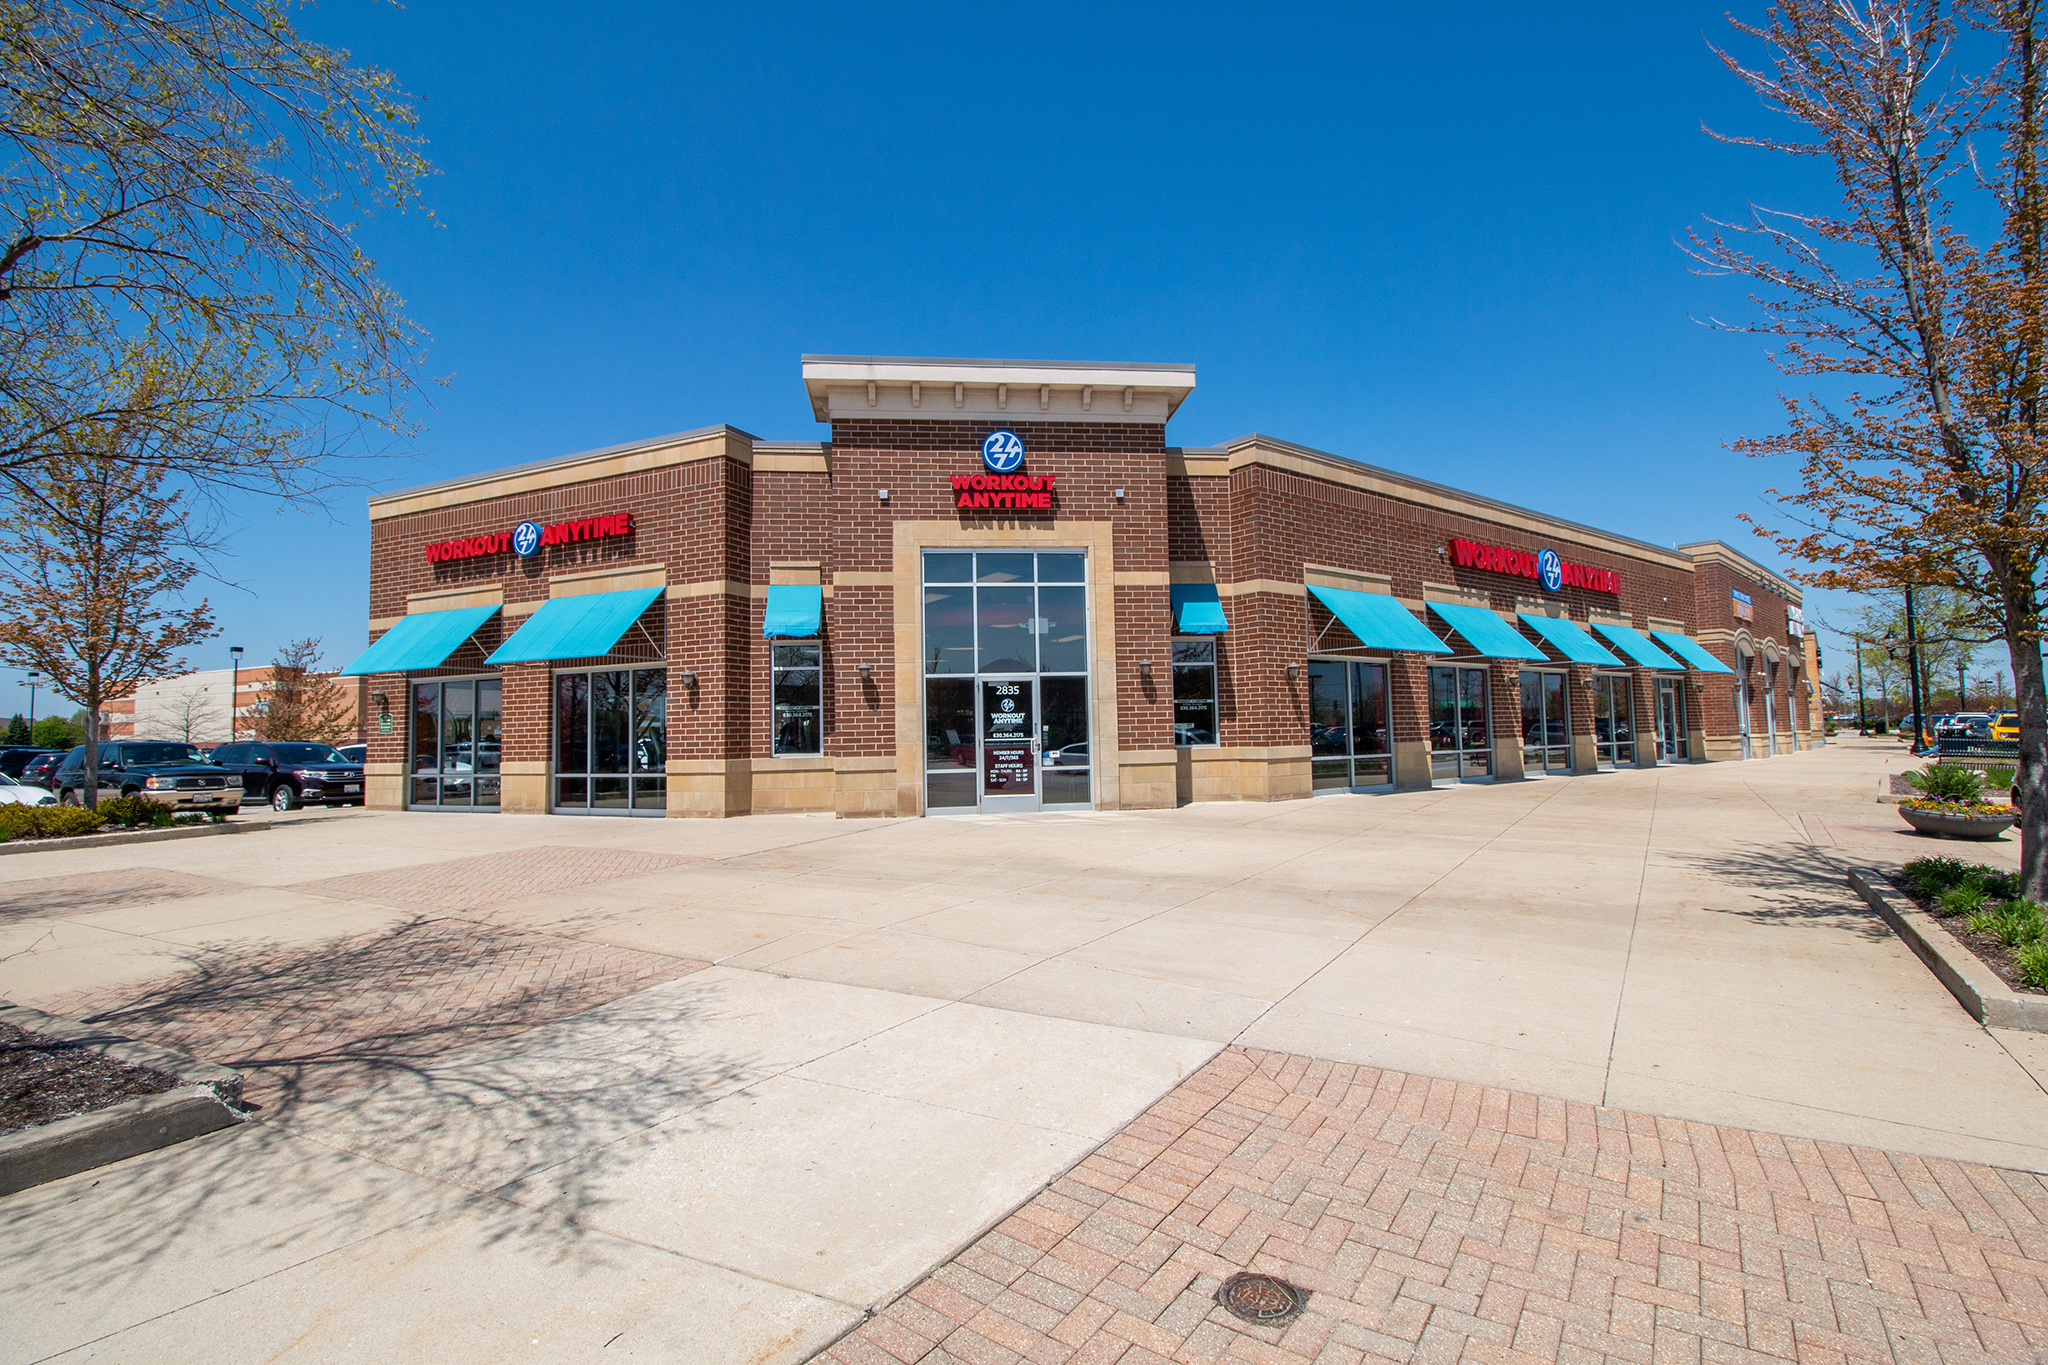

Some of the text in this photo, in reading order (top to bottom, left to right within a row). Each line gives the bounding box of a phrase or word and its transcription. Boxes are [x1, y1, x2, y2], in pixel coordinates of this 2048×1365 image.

[950, 474, 1056, 491] WORKOUT
[956, 492, 1052, 508] ANYTIME
[539, 513, 631, 546] ANYTIME
[424, 531, 512, 563] WORKOUT
[1450, 538, 1540, 579] WORKOUT
[1562, 562, 1622, 595] ANYTIME
[996, 685, 1020, 695] 2835
